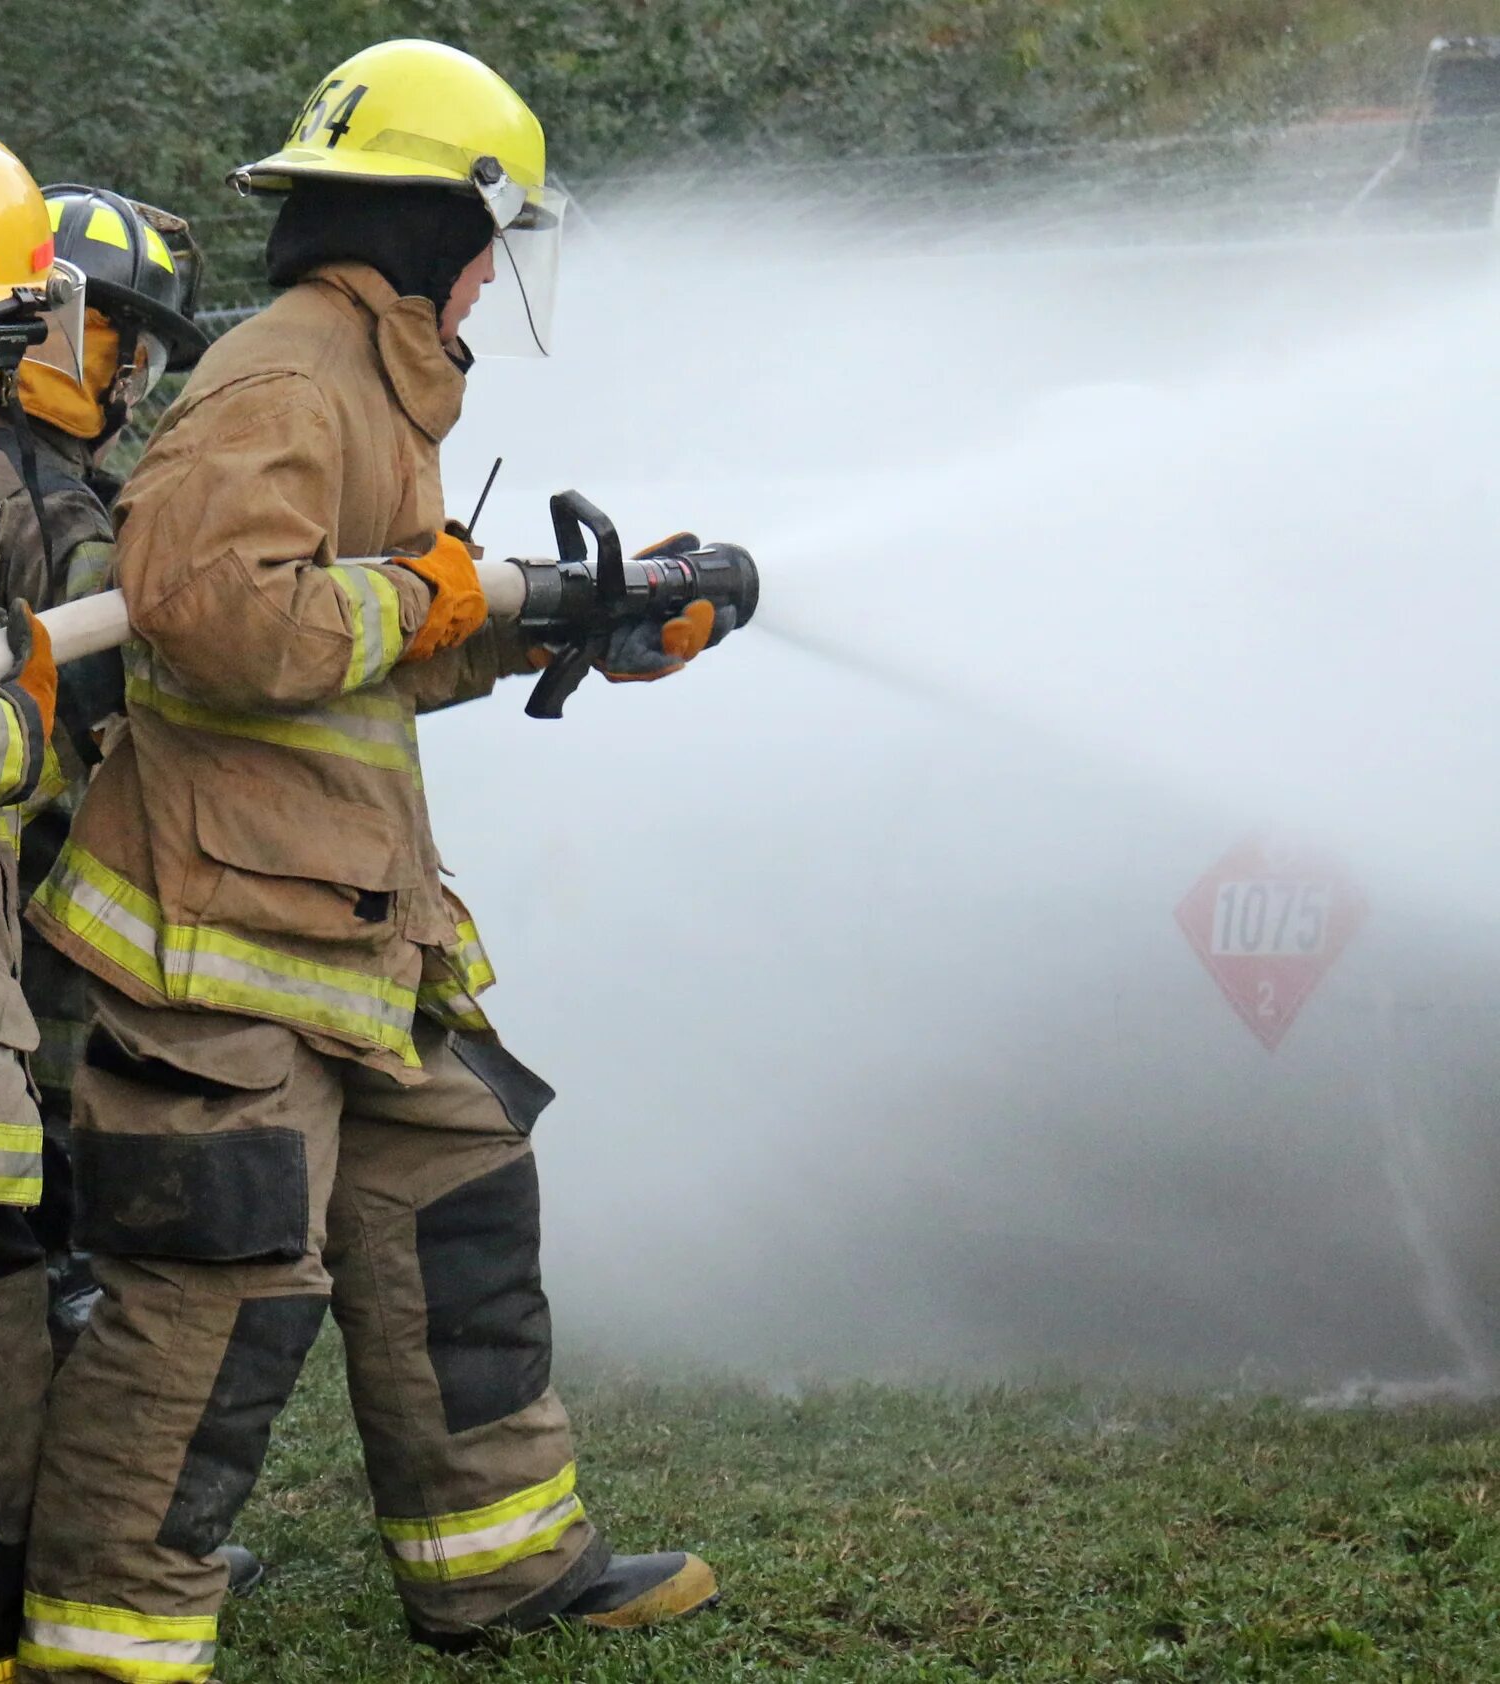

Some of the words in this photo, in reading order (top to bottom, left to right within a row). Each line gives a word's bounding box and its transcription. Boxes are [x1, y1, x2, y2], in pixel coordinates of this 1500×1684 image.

[283, 80, 369, 149] 54
[1220, 883, 1324, 952] 1075
[1257, 981, 1275, 1016] 2
